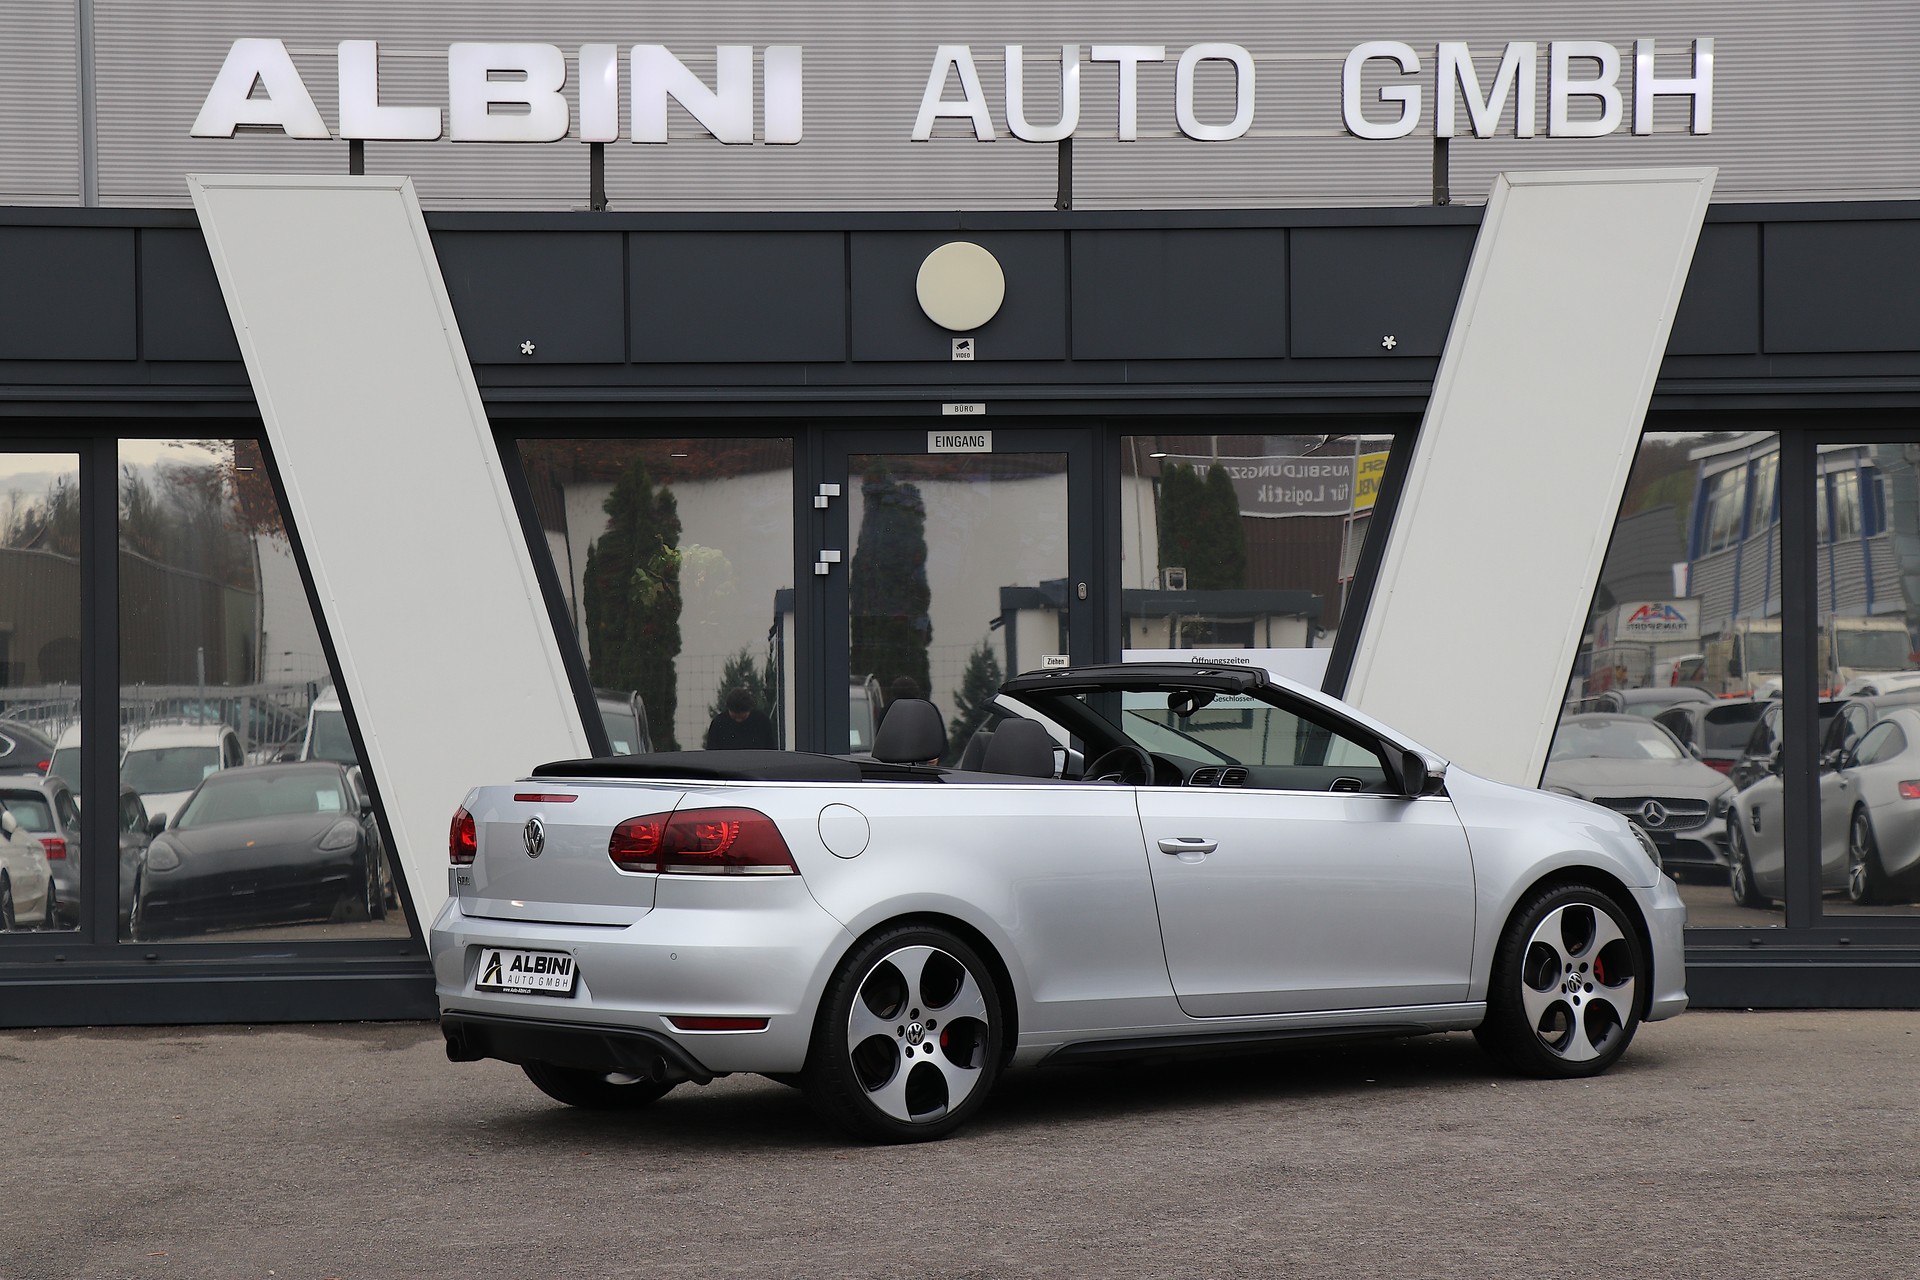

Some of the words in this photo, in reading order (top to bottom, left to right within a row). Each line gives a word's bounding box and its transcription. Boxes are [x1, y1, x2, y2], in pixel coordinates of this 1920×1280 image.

[190, 38, 802, 145] ALBINI
[911, 42, 1256, 143] AUTO
[1342, 37, 1714, 140] GMBH
[935, 436, 985, 447] EINGANG
[1191, 656, 1250, 665] Öffnungszeiten
[510, 955, 572, 975] ALBINI
[508, 975, 534, 985] AUTO
[538, 977, 569, 988] GMBH
